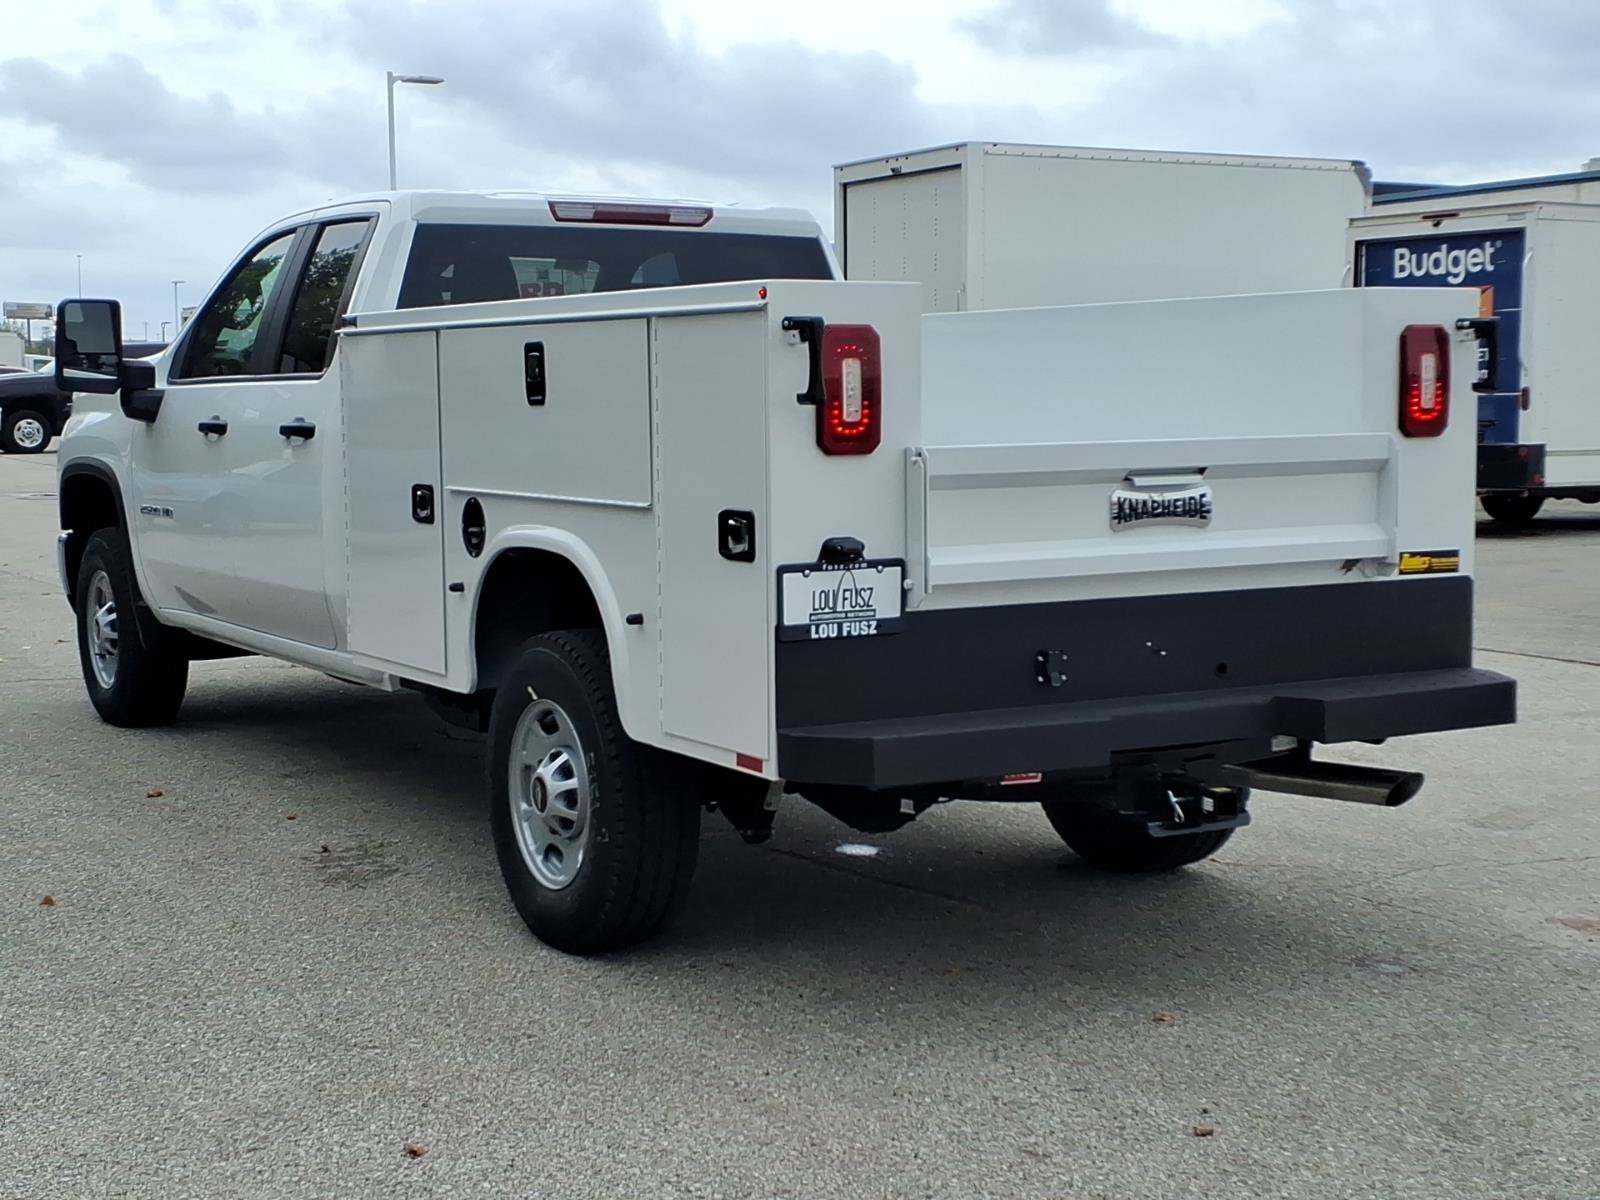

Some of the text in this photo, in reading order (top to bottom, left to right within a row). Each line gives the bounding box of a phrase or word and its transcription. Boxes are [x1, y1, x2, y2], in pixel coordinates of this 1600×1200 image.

[1393, 240, 1496, 285] Budget
[1114, 493, 1210, 525] KNAPHEIDE
[812, 587, 874, 612] LOU FUSZ
[810, 620, 878, 639] LOU FUSZ
